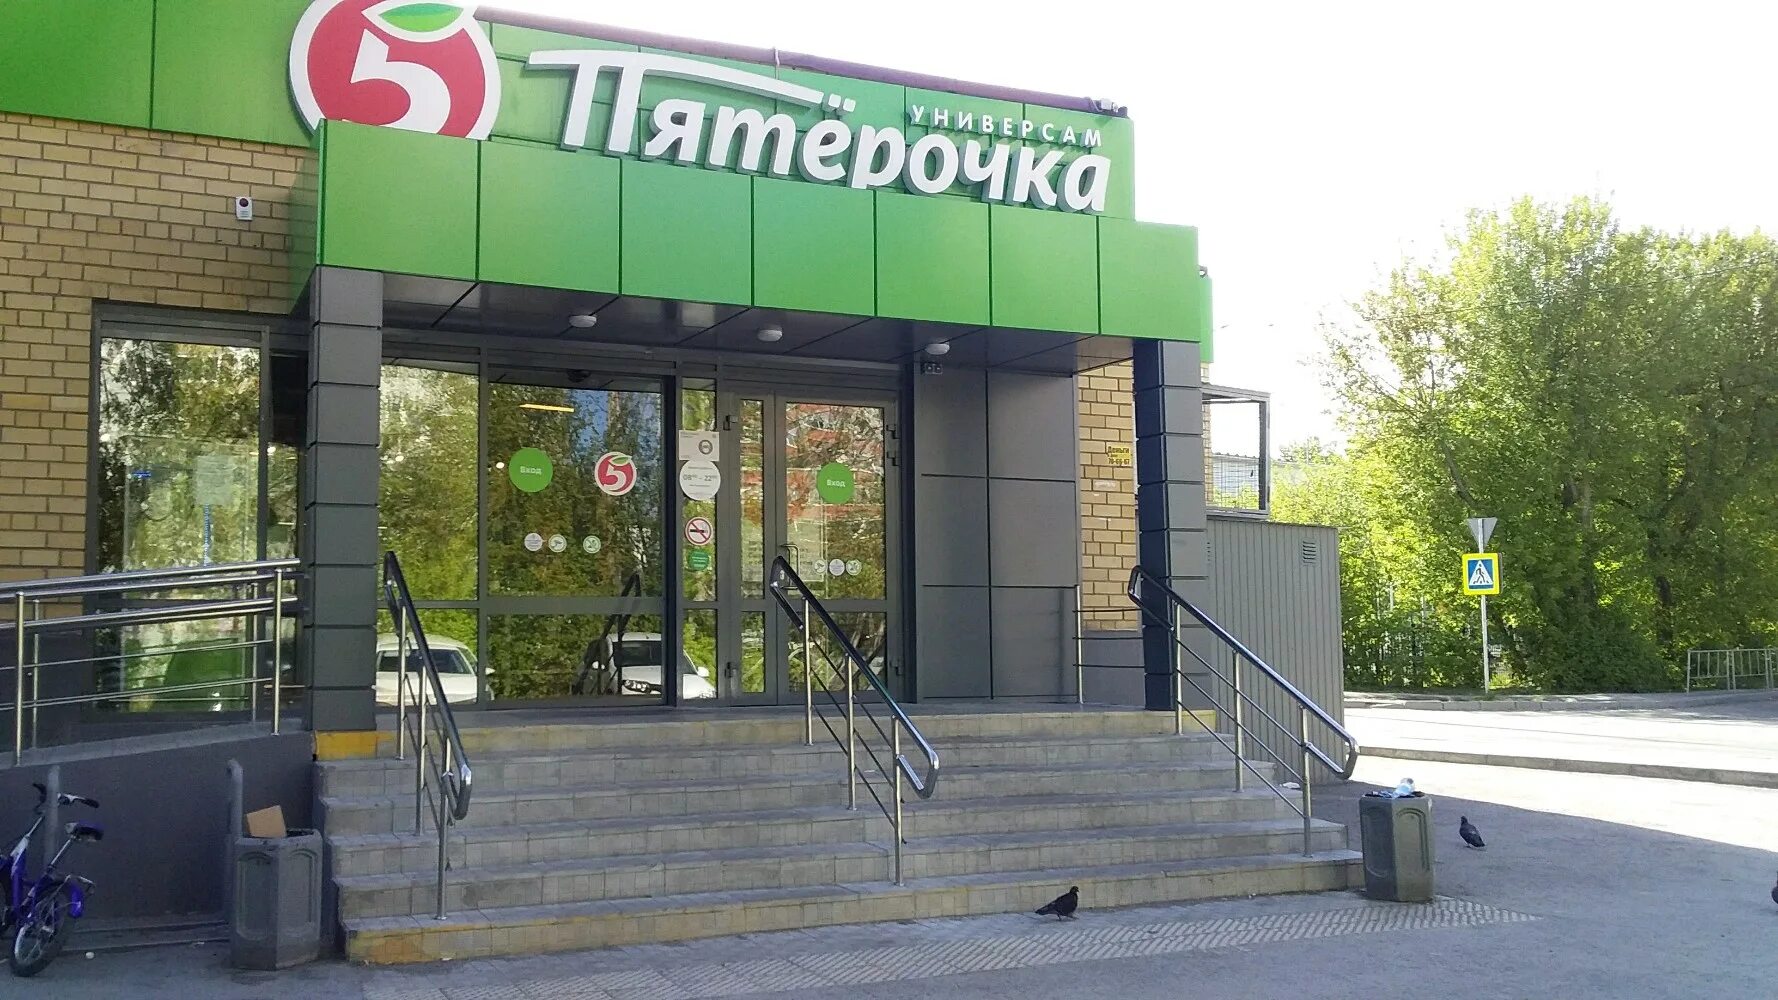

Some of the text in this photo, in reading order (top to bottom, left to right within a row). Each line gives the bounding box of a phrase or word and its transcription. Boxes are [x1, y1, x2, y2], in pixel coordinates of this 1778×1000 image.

[341, 28, 452, 134] 5
[527, 49, 1111, 212] Пятёрочка
[912, 104, 1102, 147] УНИВЕРСАМ
[520, 466, 542, 475] Вход
[826, 479, 846, 488] Вход
